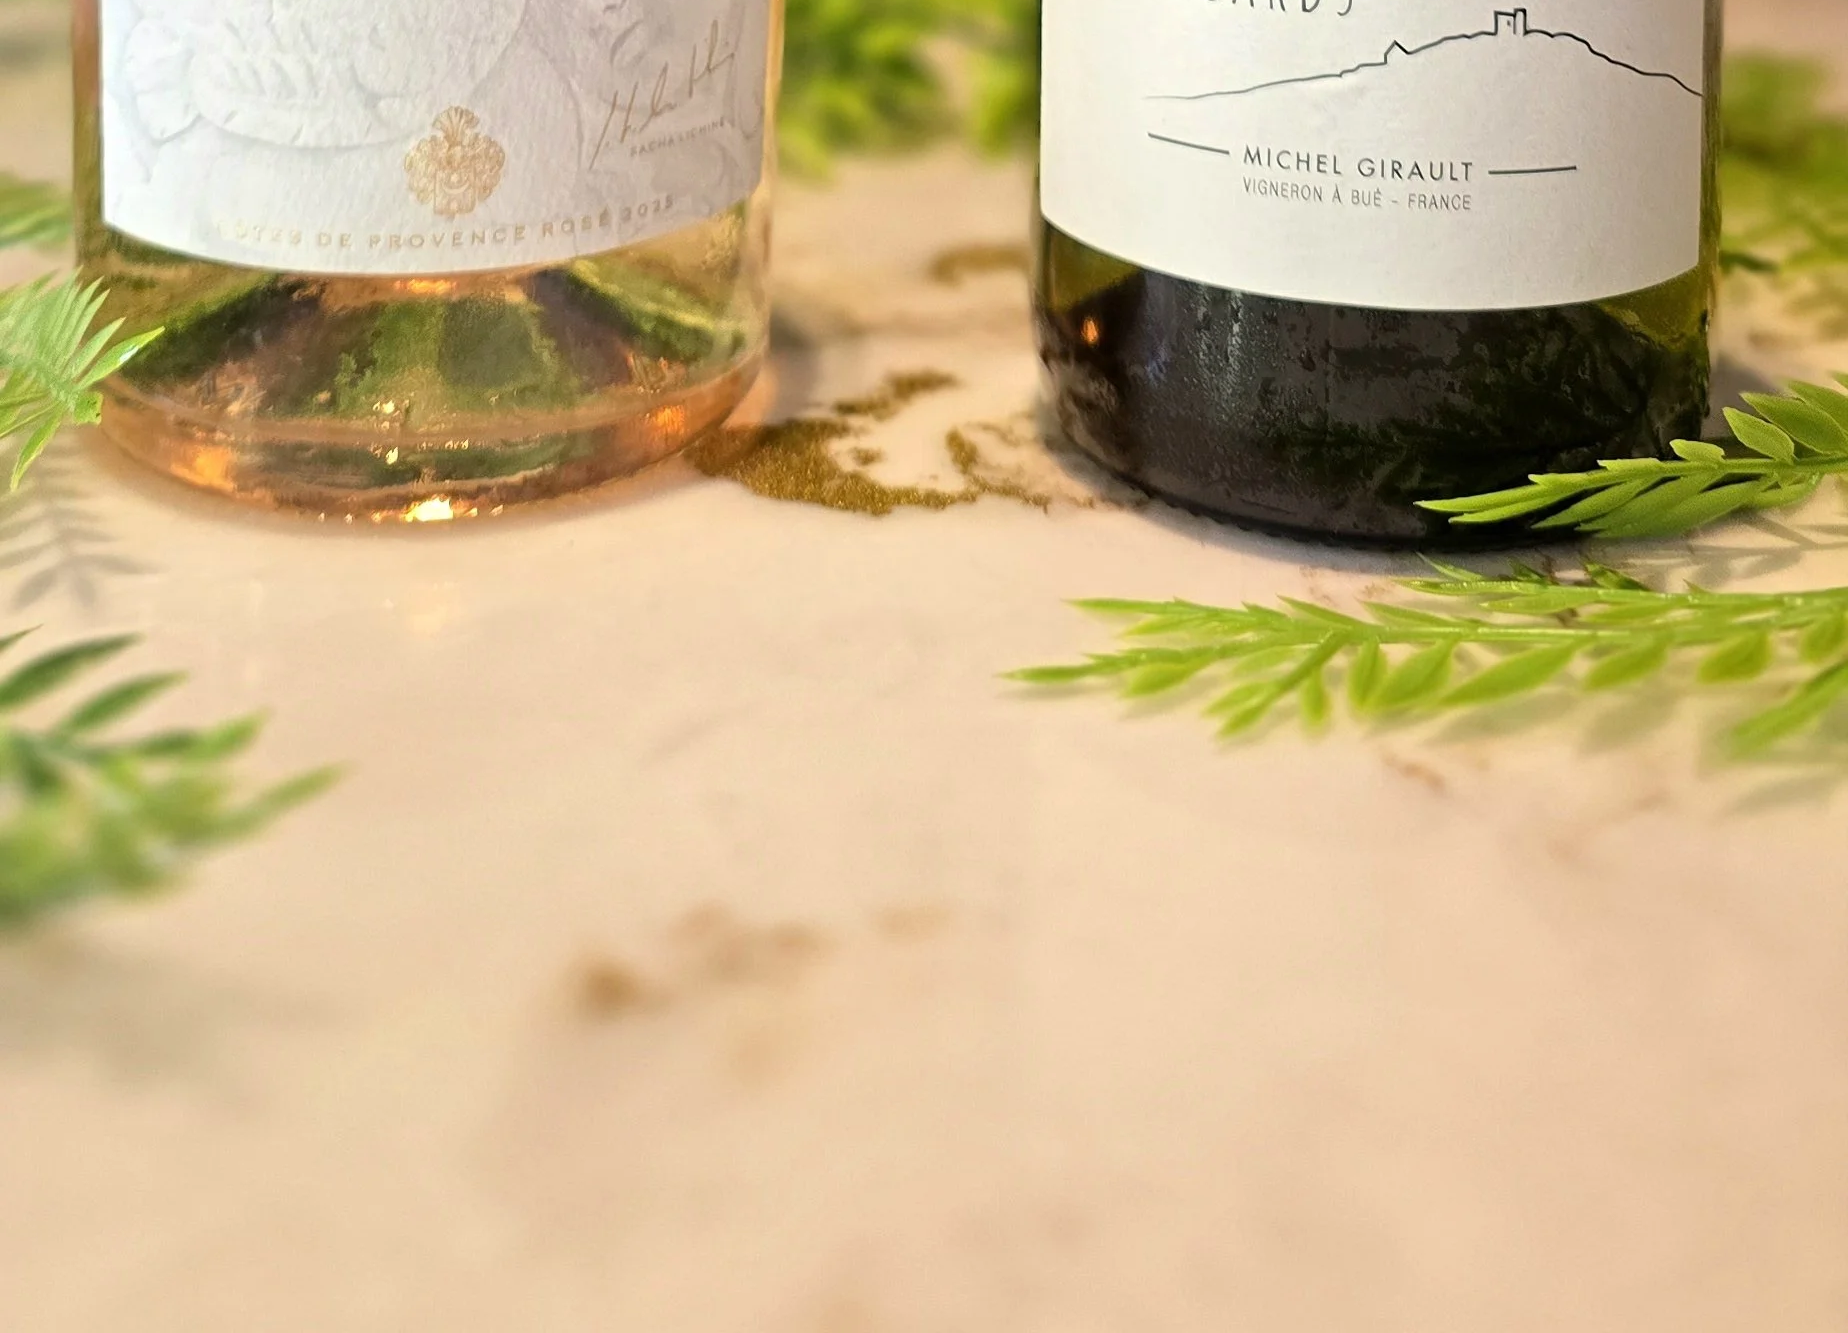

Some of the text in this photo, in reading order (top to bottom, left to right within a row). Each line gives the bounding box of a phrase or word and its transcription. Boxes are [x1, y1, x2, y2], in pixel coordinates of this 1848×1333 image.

[1242, 144, 1474, 182] MICHEL GIRAULT
[1242, 176, 1323, 203] VIGNERON
[1350, 188, 1383, 208] BUÉ
[1407, 193, 1472, 211] FRANCE
[316, 232, 353, 247] DE
[368, 224, 526, 249] PROVENCE
[541, 205, 613, 238] ROSÉ
